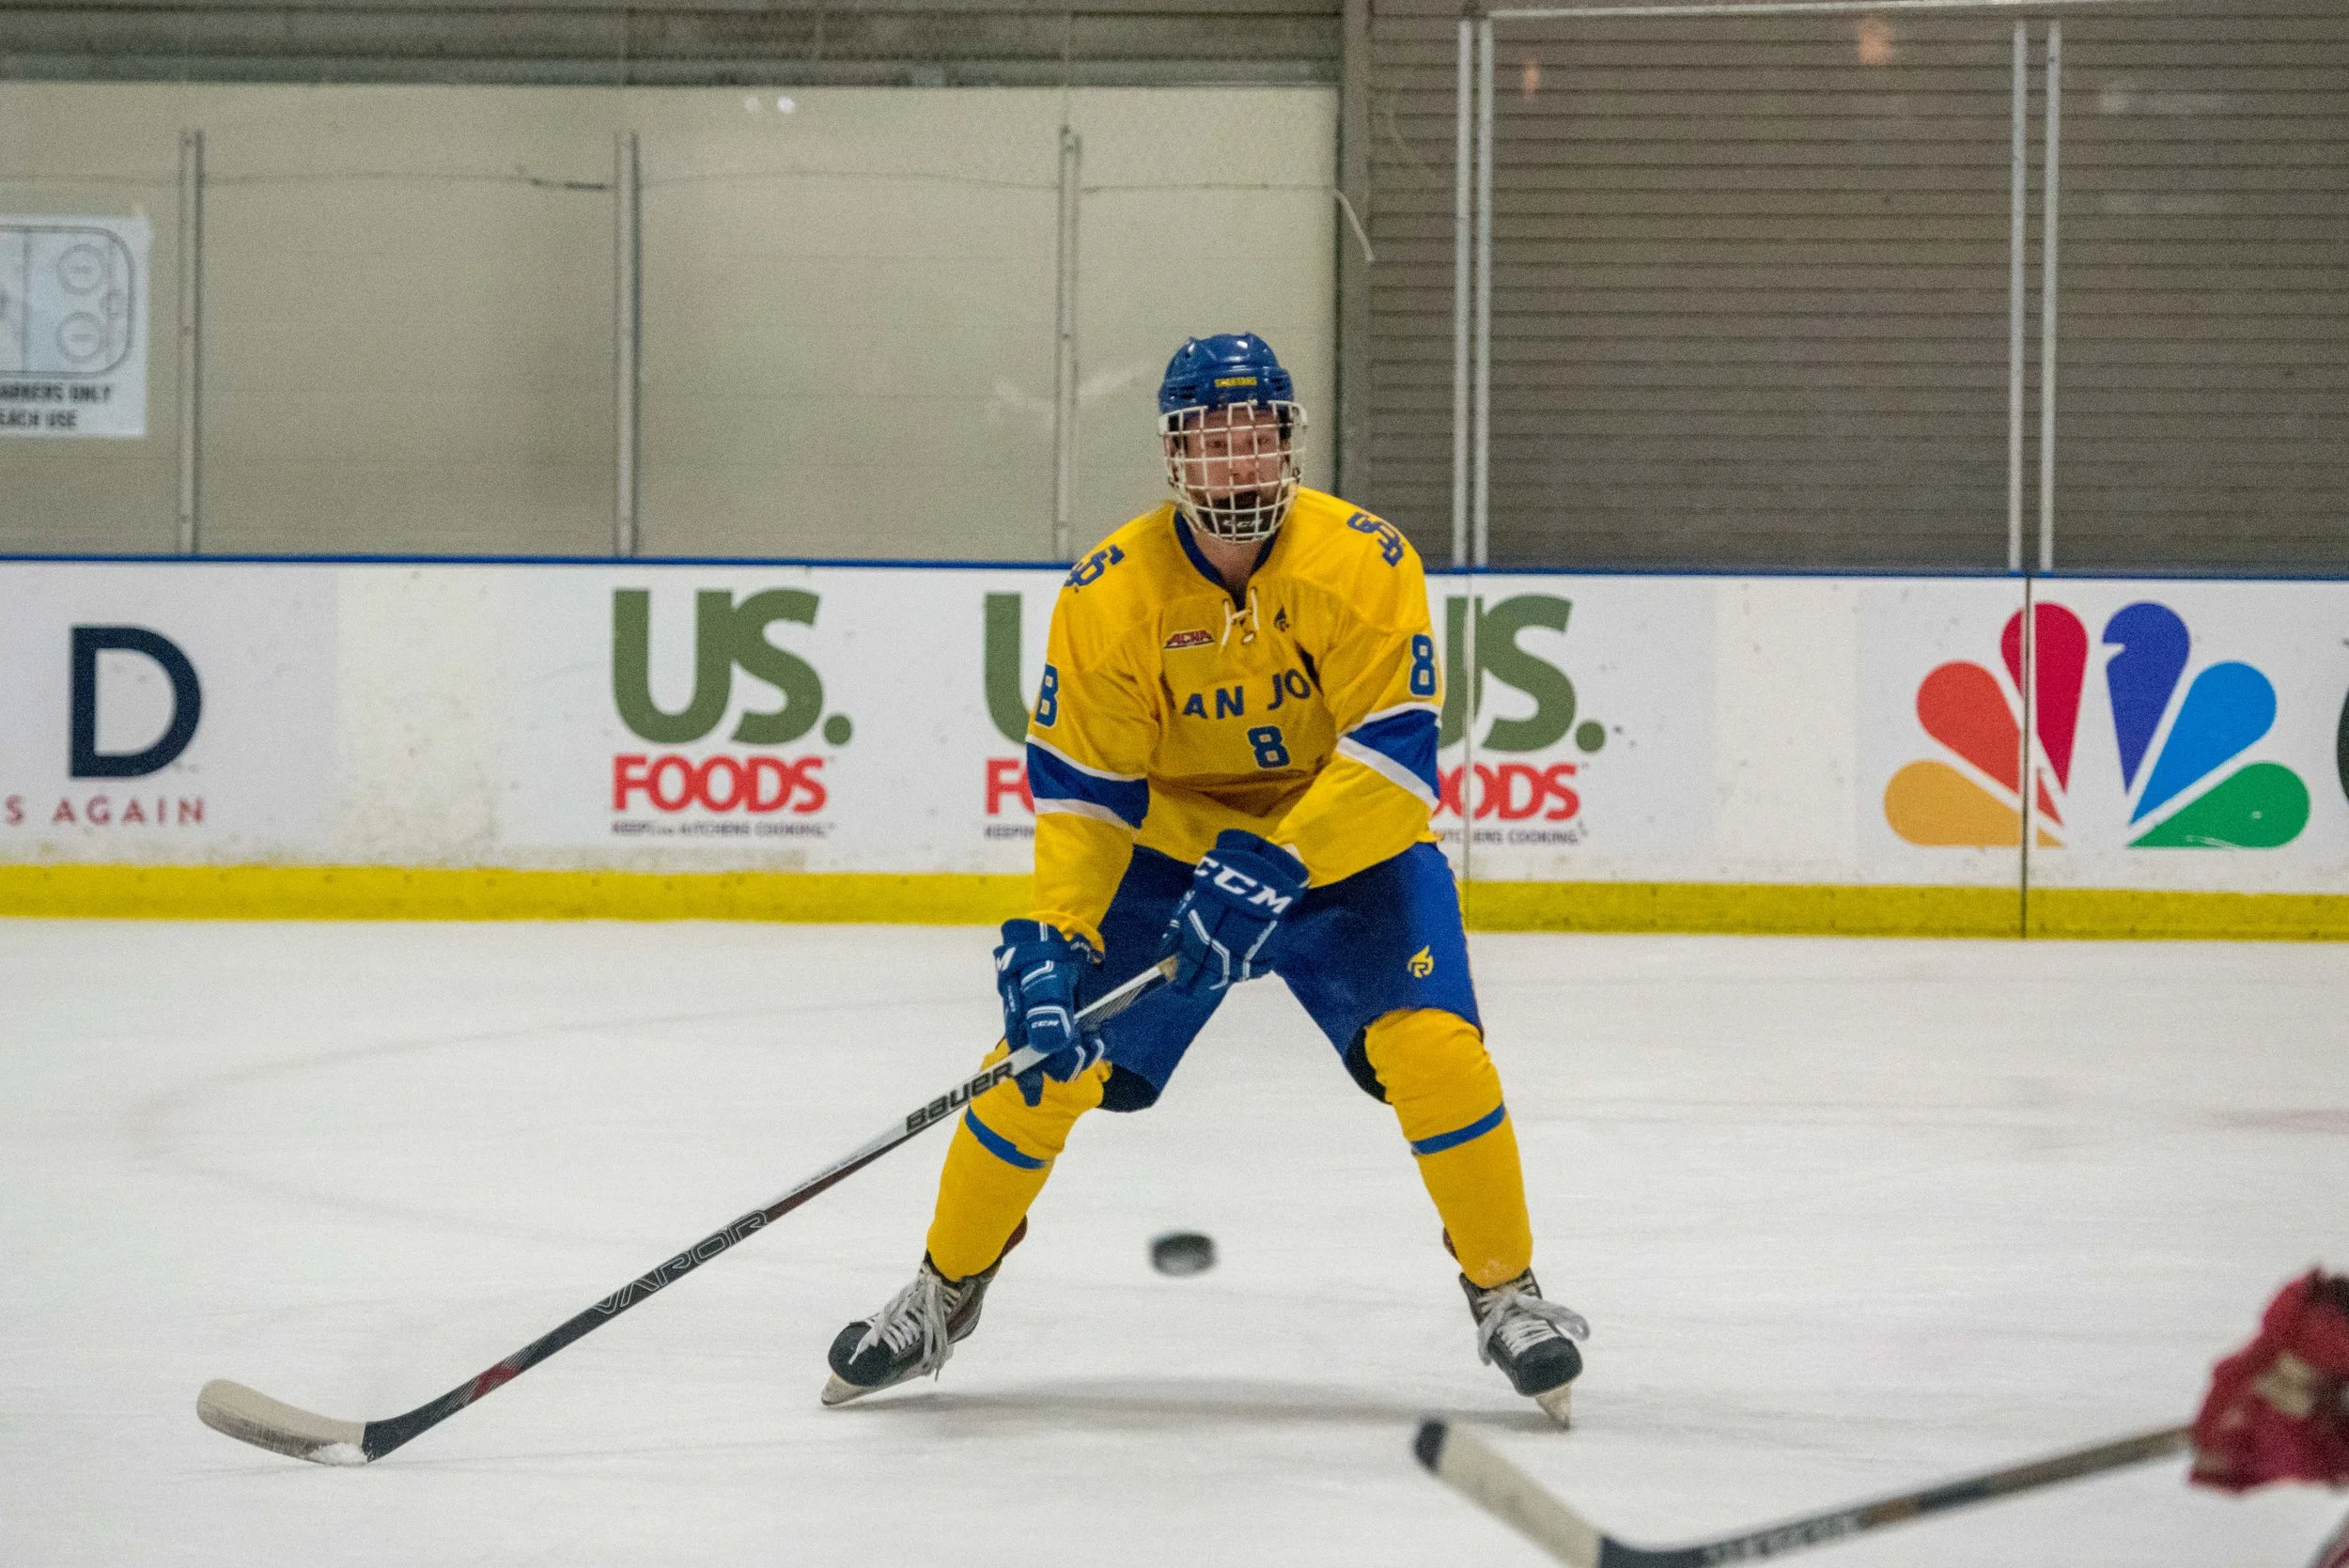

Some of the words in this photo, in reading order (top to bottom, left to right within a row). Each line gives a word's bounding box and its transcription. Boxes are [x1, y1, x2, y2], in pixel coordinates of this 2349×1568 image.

[1409, 633, 1436, 696] 8
[70, 625, 202, 780] D
[1246, 724, 1291, 769] 8
[52, 796, 205, 827] AGAIN
[614, 753, 828, 815] FOODS
[1194, 856, 1293, 915] CCM
[907, 1062, 1015, 1133] BAUER
[591, 1210, 768, 1315] VAPOR
